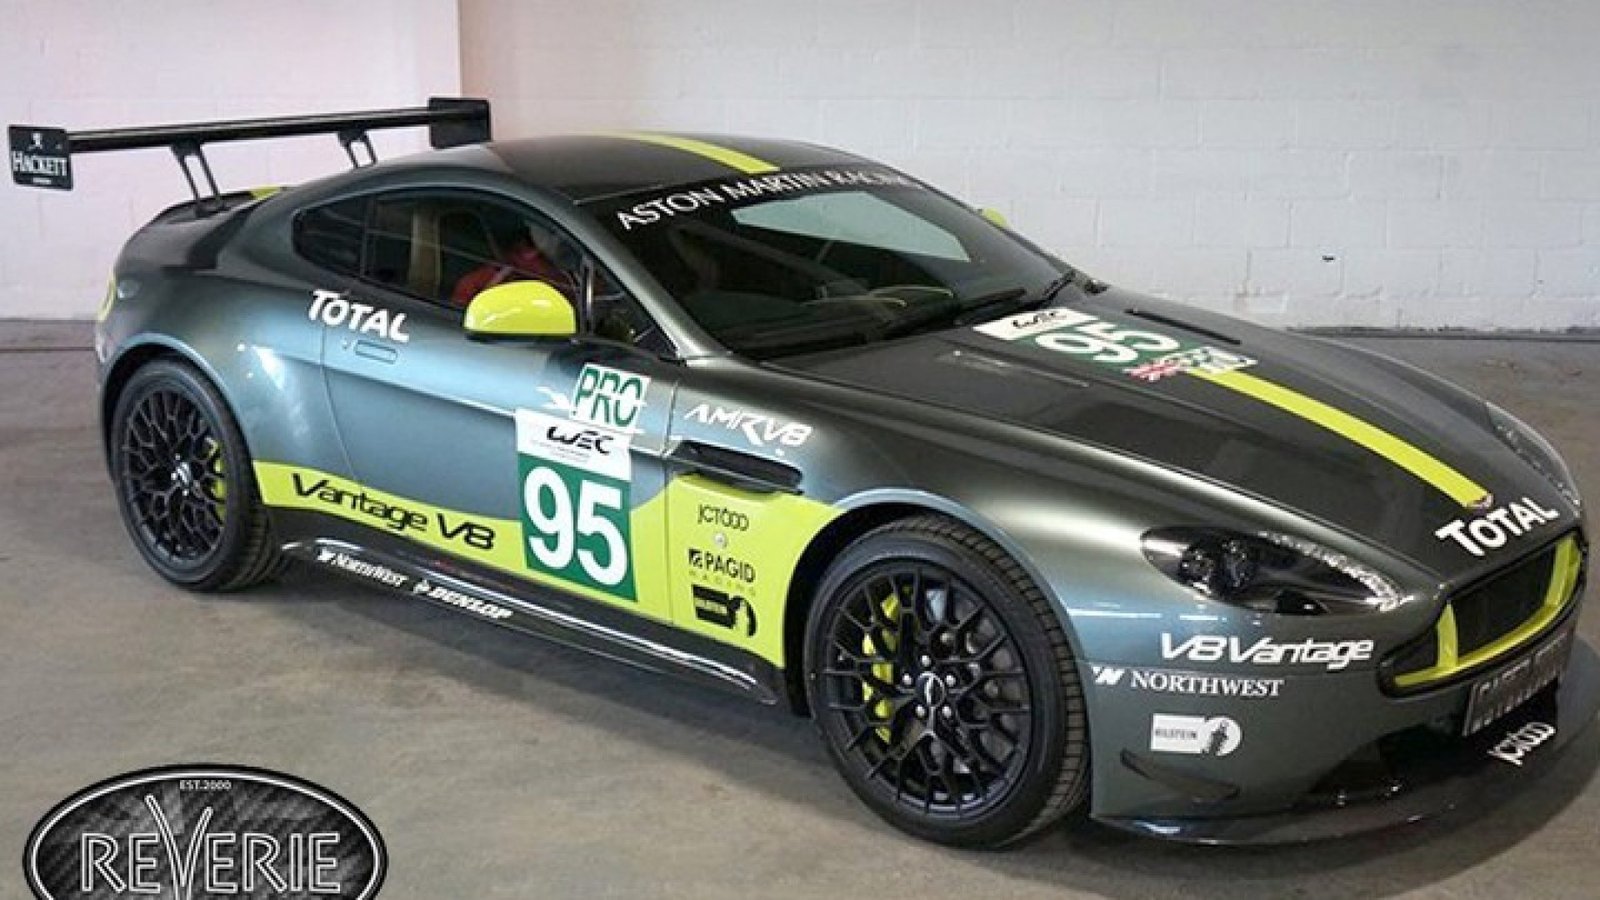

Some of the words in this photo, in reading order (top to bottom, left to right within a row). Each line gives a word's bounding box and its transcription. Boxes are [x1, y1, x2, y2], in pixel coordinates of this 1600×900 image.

[12, 151, 68, 177] HACKETT
[617, 187, 726, 230] ASTON
[721, 170, 826, 200] MARTIN
[308, 289, 410, 343] TOTAL
[1035, 322, 1181, 362] 95
[573, 367, 643, 428] PRO
[546, 425, 615, 455] WEC
[292, 472, 428, 531] Vantage
[437, 512, 496, 550] V8
[523, 466, 628, 587] 95
[1435, 496, 1560, 557] TOTAL
[704, 550, 757, 583] PAGID
[1161, 632, 1227, 661] V8
[1229, 637, 1374, 670] Vantage
[1130, 670, 1286, 697] NORTHWEST
